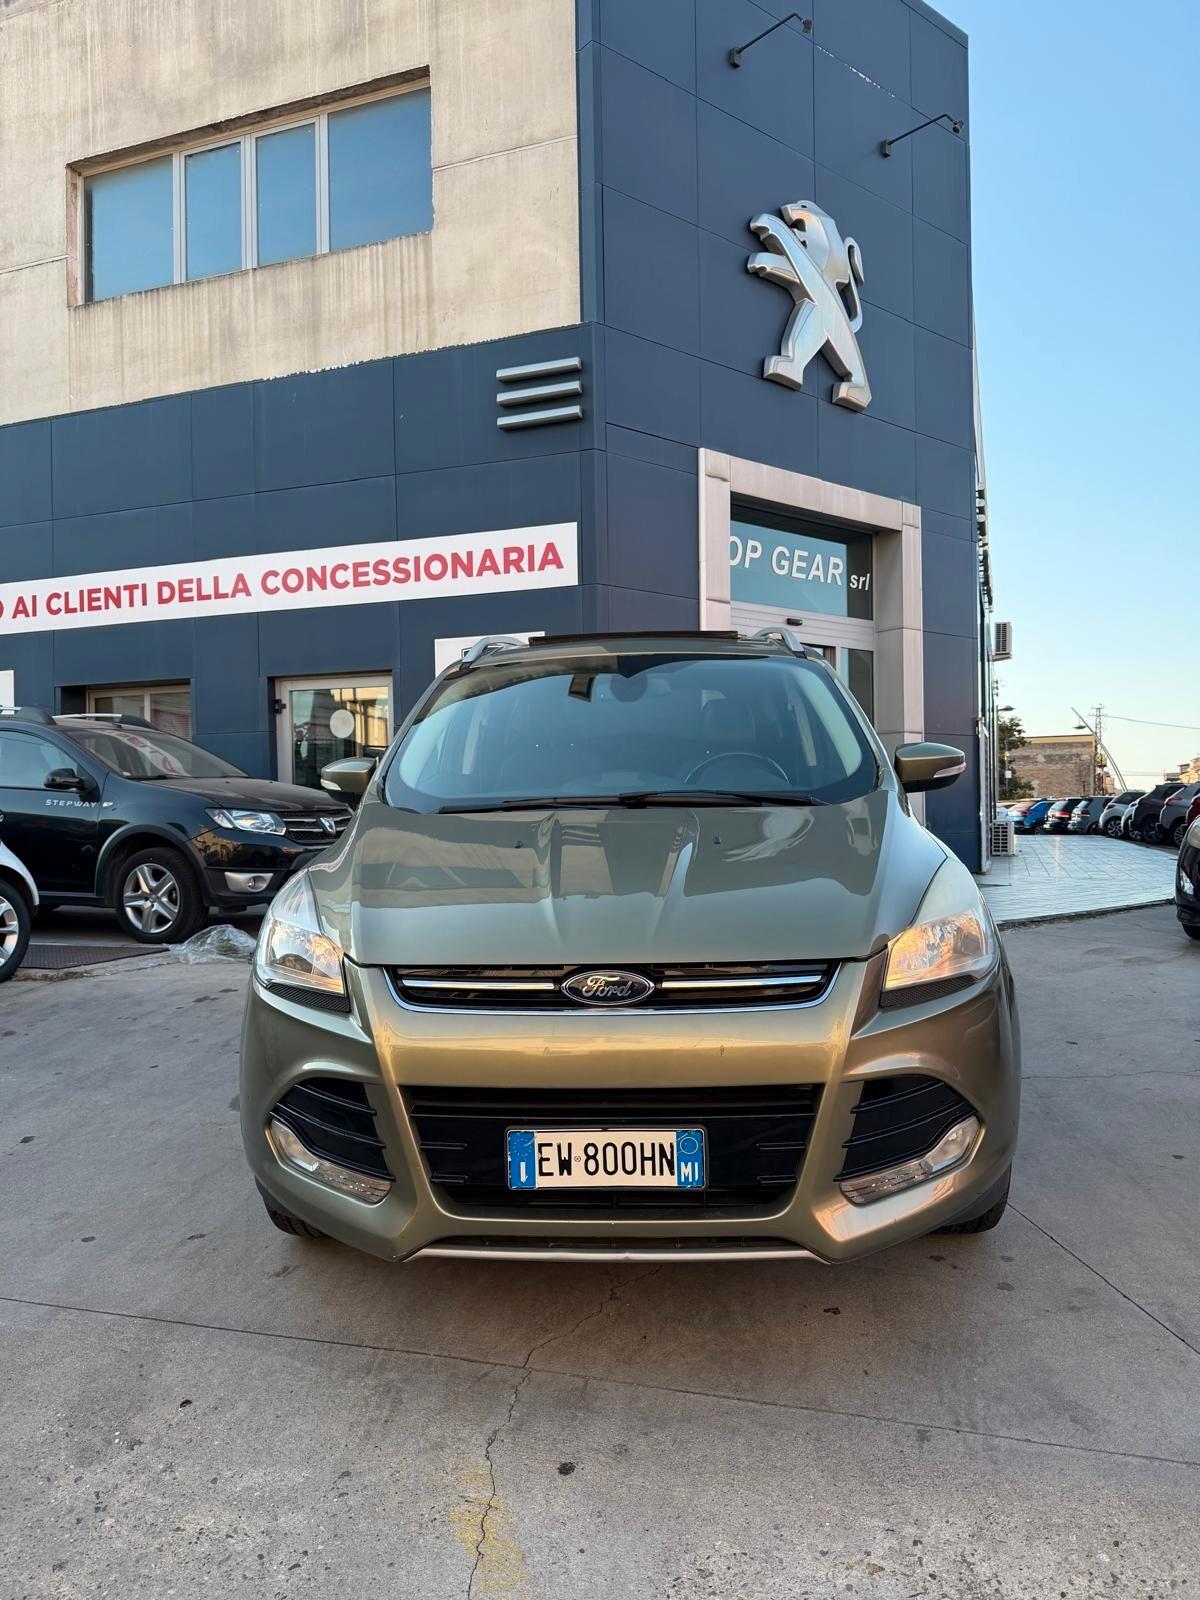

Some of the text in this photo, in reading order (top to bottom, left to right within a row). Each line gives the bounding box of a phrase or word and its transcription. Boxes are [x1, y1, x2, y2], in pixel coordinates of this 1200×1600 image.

[771, 546, 844, 586] GEAR
[849, 573, 870, 591] srl
[12, 595, 37, 619] AI
[45, 583, 148, 616] CLIENTI
[157, 573, 252, 605] DELLA
[260, 542, 564, 596] CONCESSIONARIA
[45, 799, 97, 808] STEPWAY
[582, 975, 632, 997] Ford
[680, 1161, 699, 1183] MI
